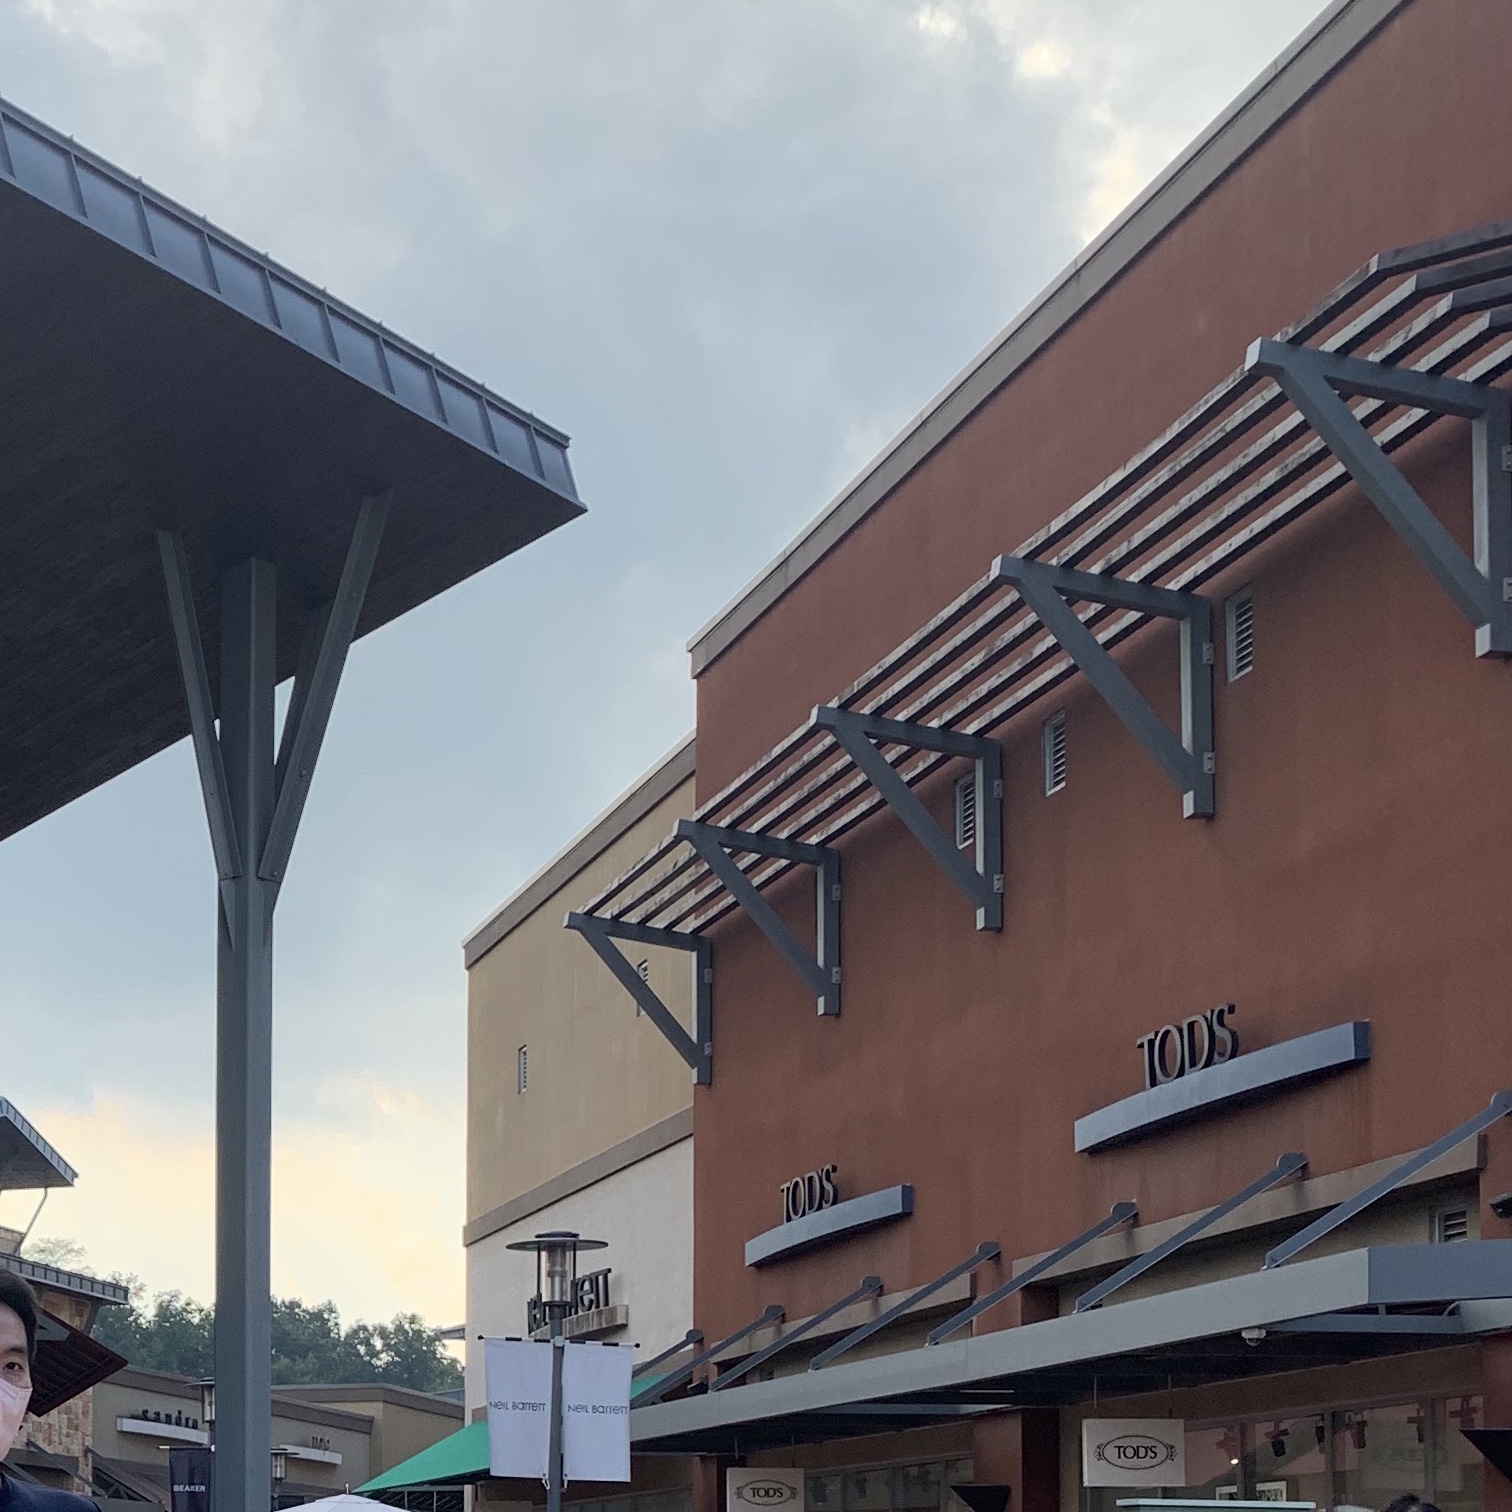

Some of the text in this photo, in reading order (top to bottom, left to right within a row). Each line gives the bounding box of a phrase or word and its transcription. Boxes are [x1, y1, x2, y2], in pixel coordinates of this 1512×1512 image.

[1136, 1003, 1239, 1091] TOD'S
[780, 1165, 839, 1225] TOD'S
[1113, 1445, 1158, 1460] TOD'S
[173, 1484, 206, 1493] BEAKER
[750, 1487, 784, 1498] TOD'S
